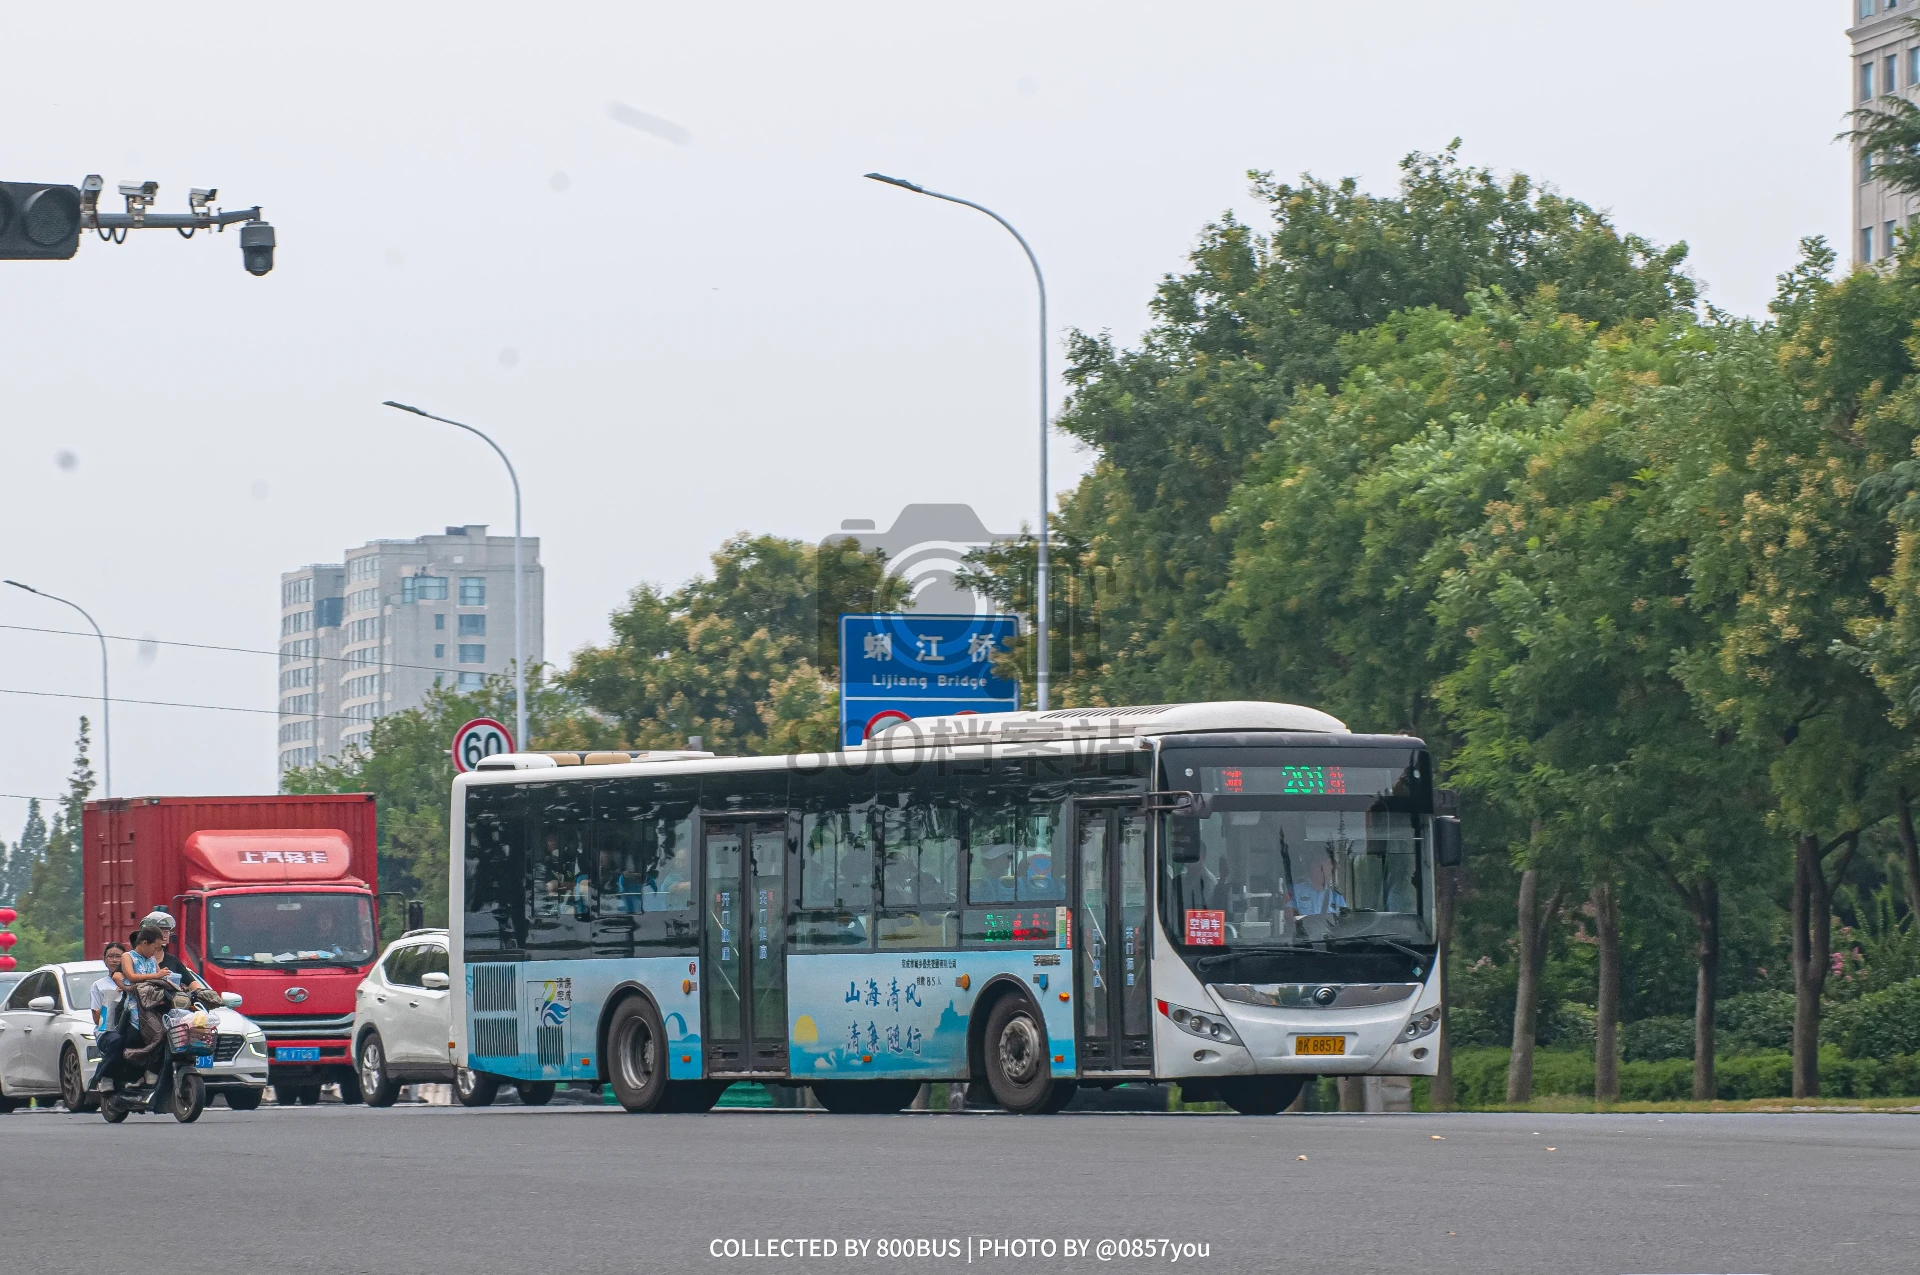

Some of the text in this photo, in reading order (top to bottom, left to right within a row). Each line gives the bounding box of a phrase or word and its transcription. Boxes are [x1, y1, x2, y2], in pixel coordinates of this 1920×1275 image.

[872, 674, 988, 691] Lijiang Bridge
[464, 732, 502, 770] 60
[240, 851, 328, 864] 上汽轻卡
[1189, 918, 1221, 931] 空调车
